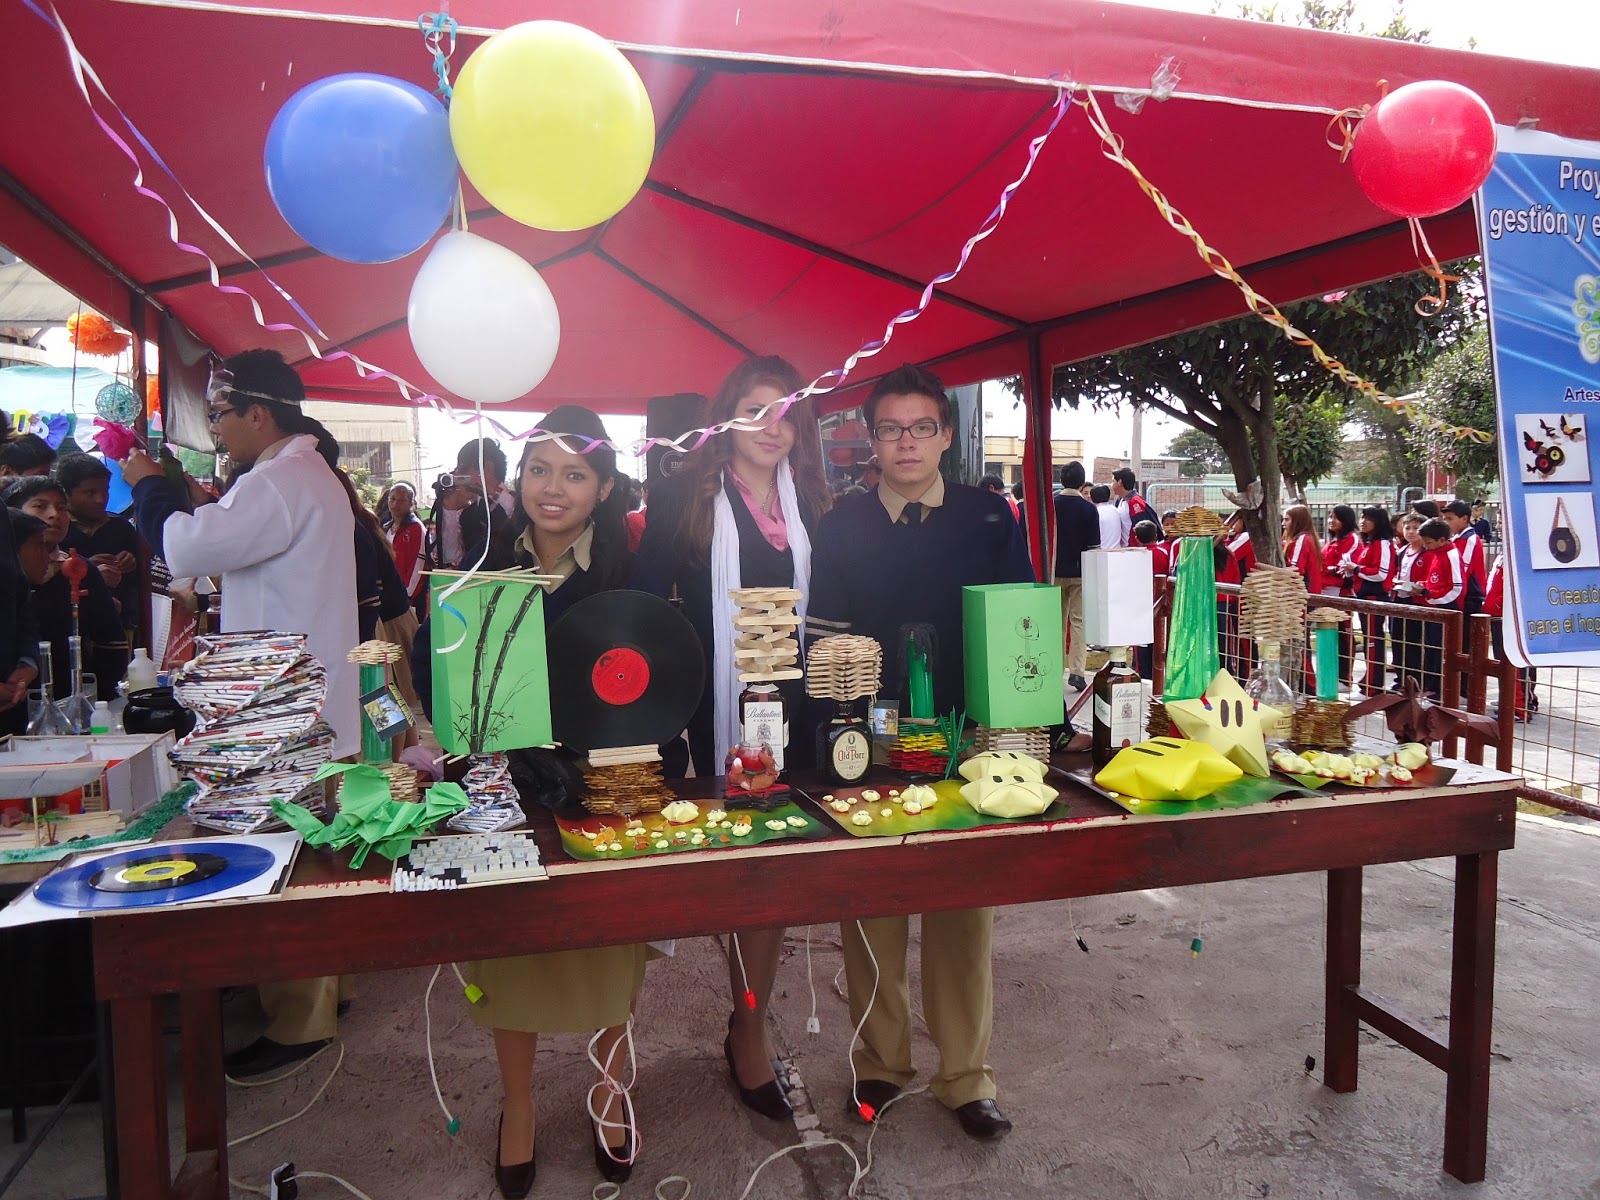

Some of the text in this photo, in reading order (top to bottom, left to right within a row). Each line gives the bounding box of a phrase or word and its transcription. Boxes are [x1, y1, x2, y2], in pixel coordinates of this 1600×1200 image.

[1559, 160, 1600, 199] Proy
[1489, 204, 1568, 240] gestión
[1574, 214, 1586, 243] y
[1563, 387, 1600, 402] Artes
[1527, 618, 1560, 640] para
[1563, 613, 1575, 633] el
[837, 749, 865, 762] Old Parr
